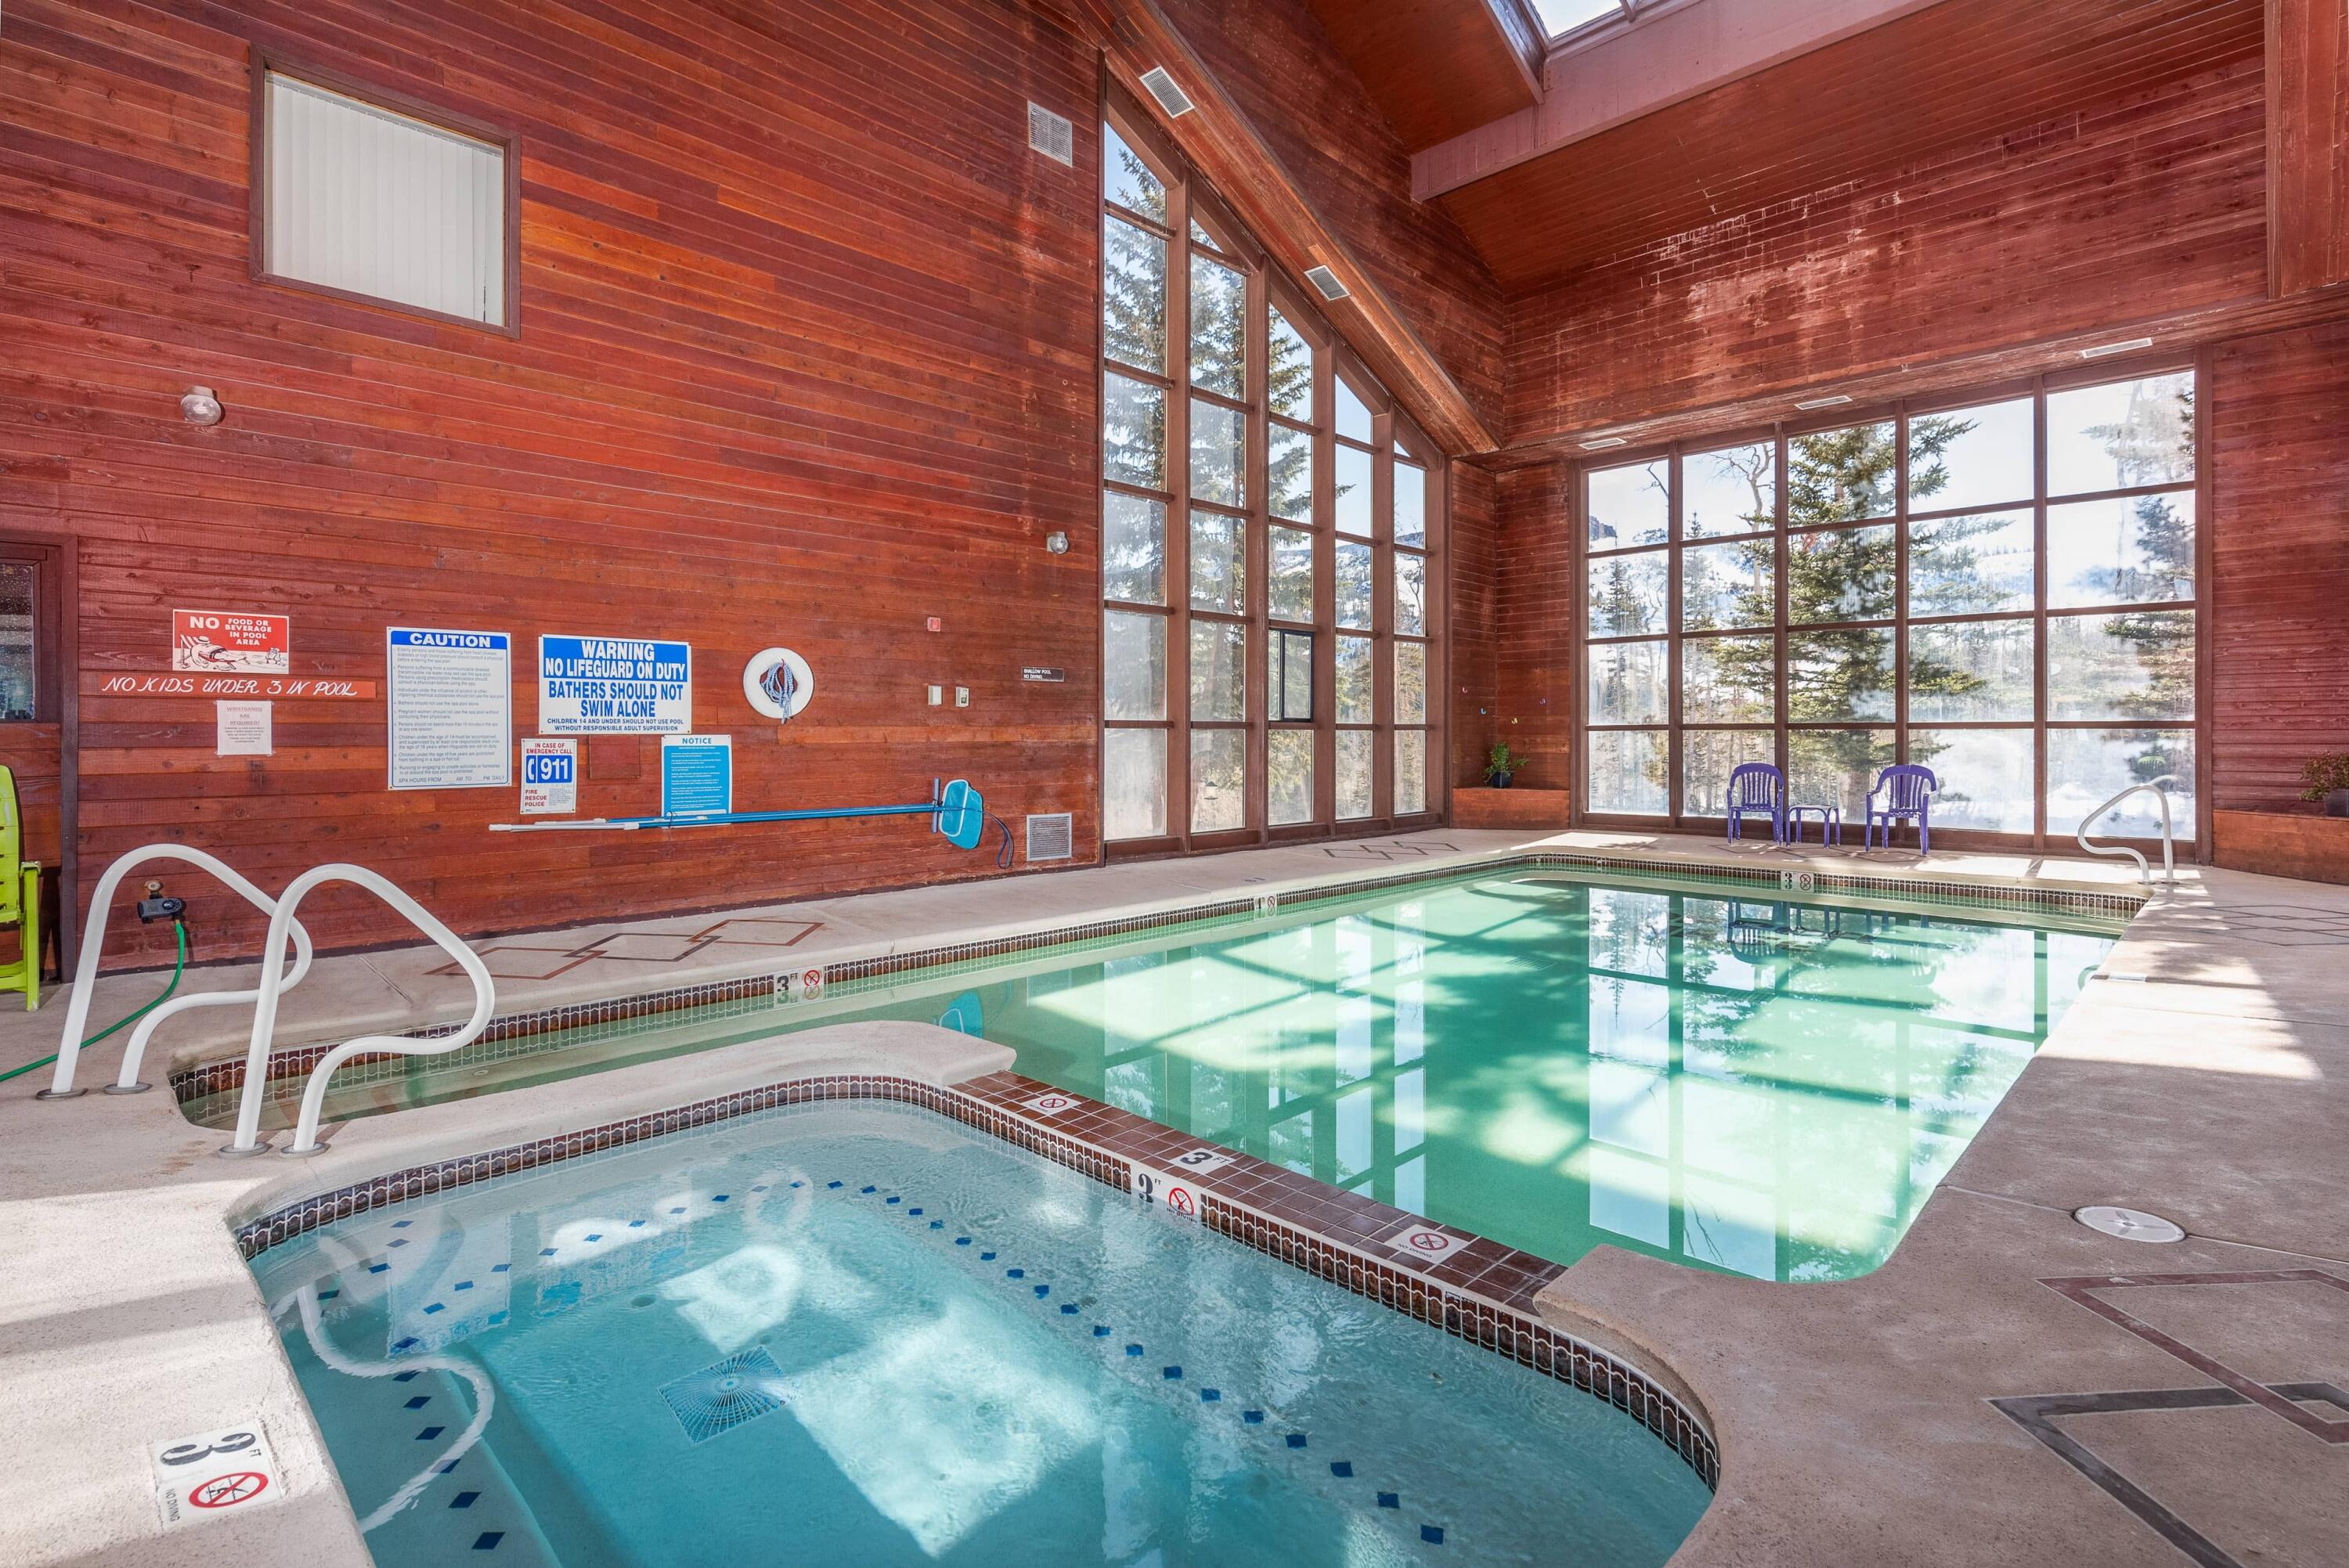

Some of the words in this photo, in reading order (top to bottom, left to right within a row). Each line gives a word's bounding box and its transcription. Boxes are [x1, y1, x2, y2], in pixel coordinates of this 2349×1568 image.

[190, 616, 219, 629] NO
[410, 633, 491, 648] CAUTION
[581, 640, 655, 661] WARNING
[545, 658, 563, 676] NO
[567, 658, 634, 678] LIFEGUARD
[637, 661, 653, 679] ON
[656, 663, 685, 680] DUTY
[102, 677, 136, 691] NO
[137, 677, 194, 692] KIDS
[202, 679, 260, 694] UNDER
[267, 680, 282, 694] 3
[286, 681, 311, 695] IN
[313, 681, 357, 696] POOL
[549, 681, 606, 698] BATHERS
[610, 682, 657, 700] SHOULD
[661, 684, 683, 700] NOT
[581, 700, 613, 717] SWIM
[617, 701, 655, 717] ALONE
[540, 758, 568, 780] 911
[1785, 872, 1792, 883] 3
[777, 976, 789, 992] 3
[1180, 1152, 1213, 1165] 3
[160, 1433, 256, 1465] 3
[250, 1449, 262, 1458] FT
[165, 1488, 177, 1500] NO
[167, 1500, 180, 1522] DIVING
